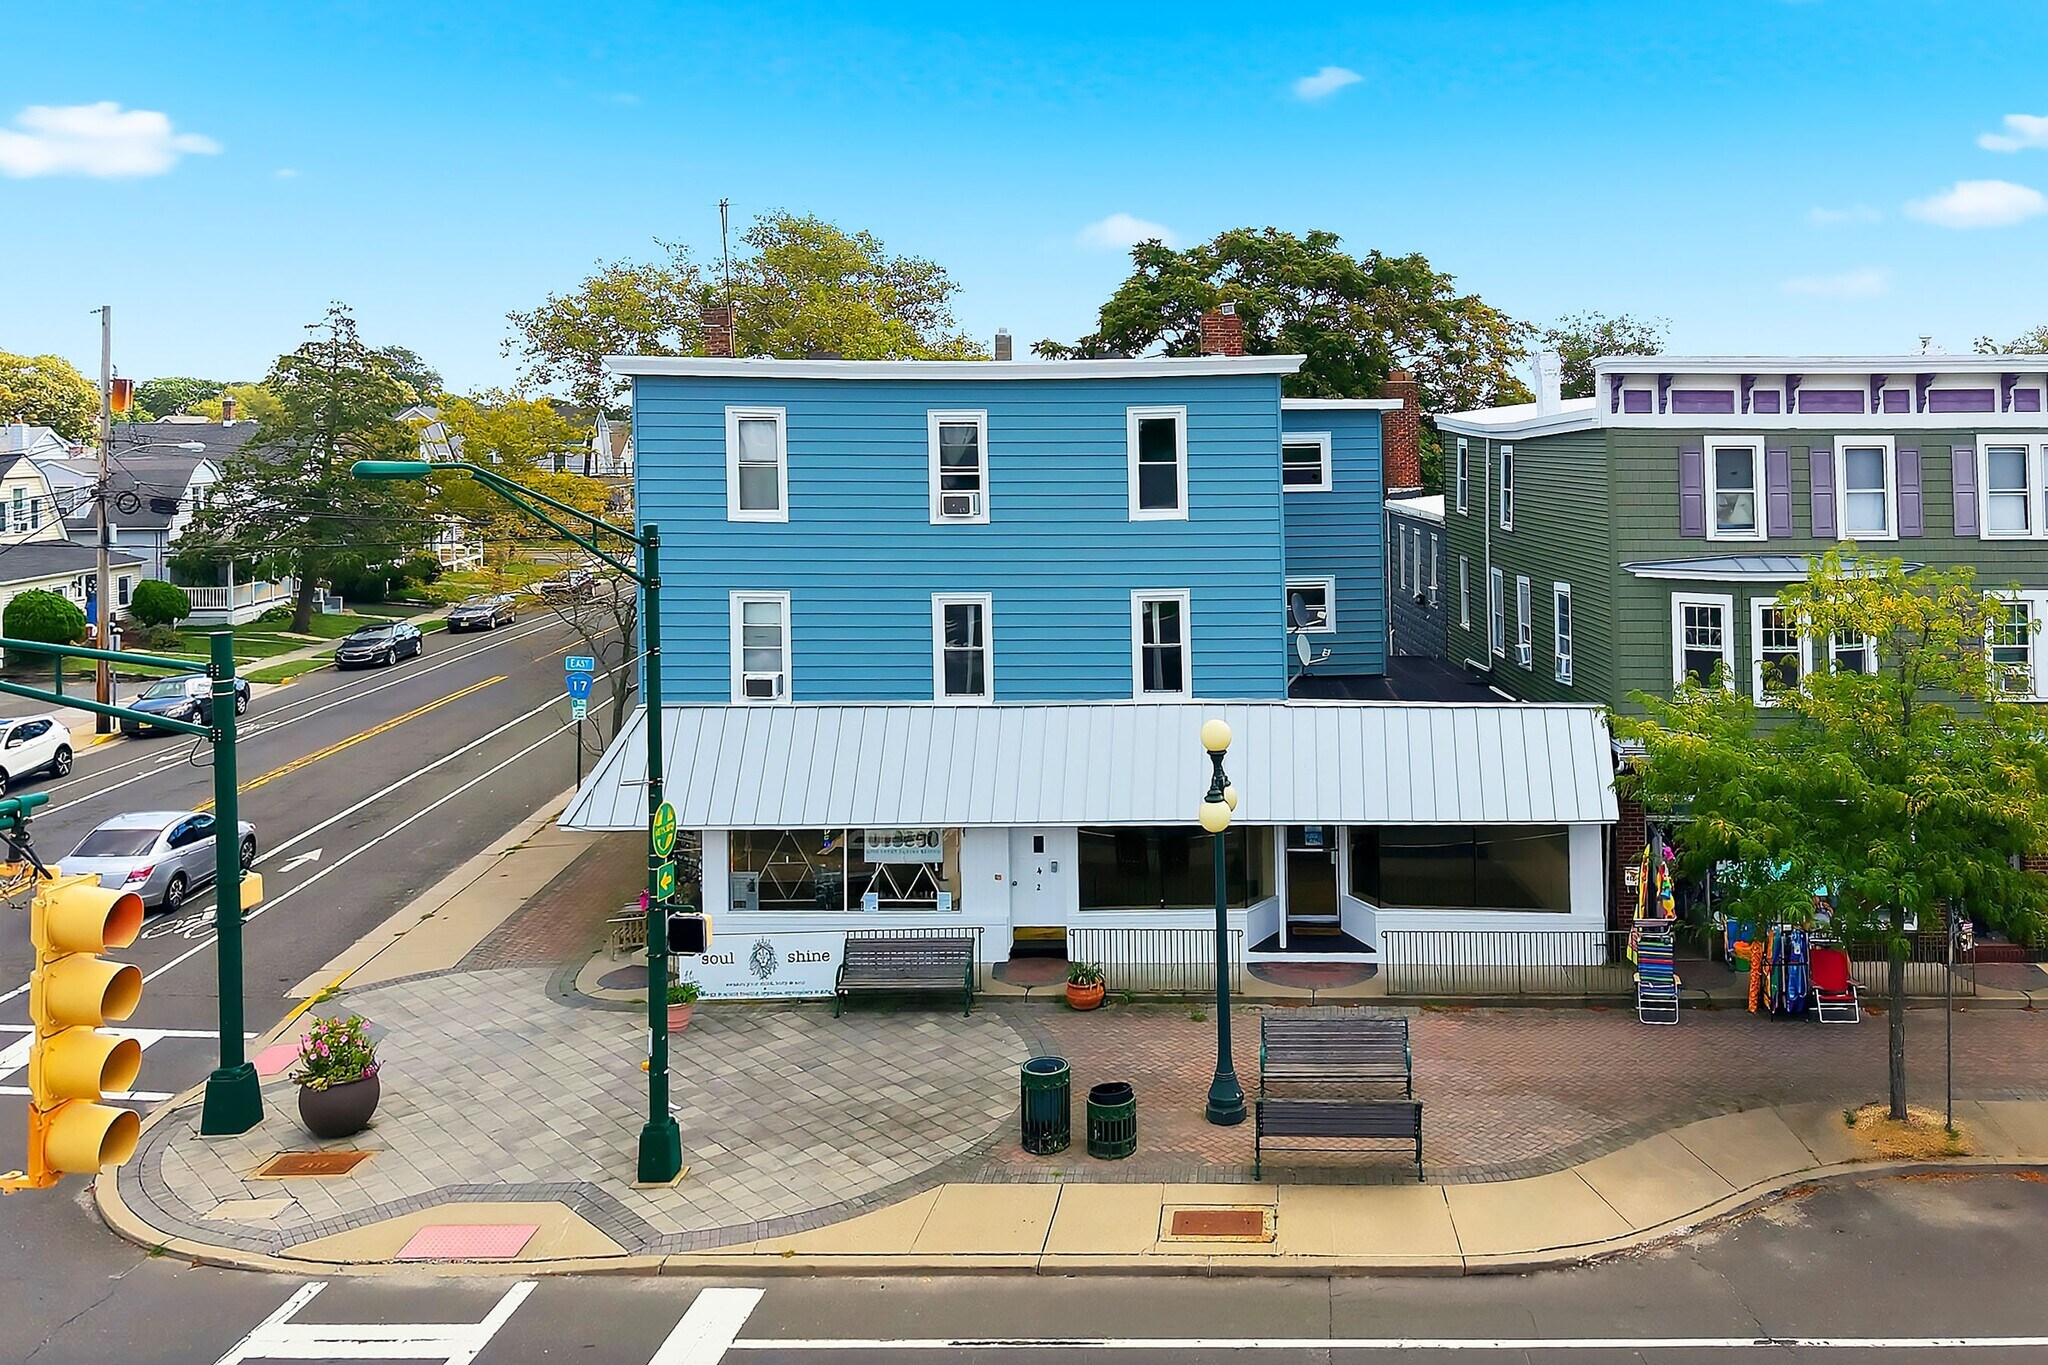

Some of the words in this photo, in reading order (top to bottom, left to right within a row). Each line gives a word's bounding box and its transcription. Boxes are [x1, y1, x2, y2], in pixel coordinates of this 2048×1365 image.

[570, 658, 590, 668] EAST
[573, 680, 588, 691] 17
[701, 951, 735, 965] soul
[787, 950, 831, 963] shine
